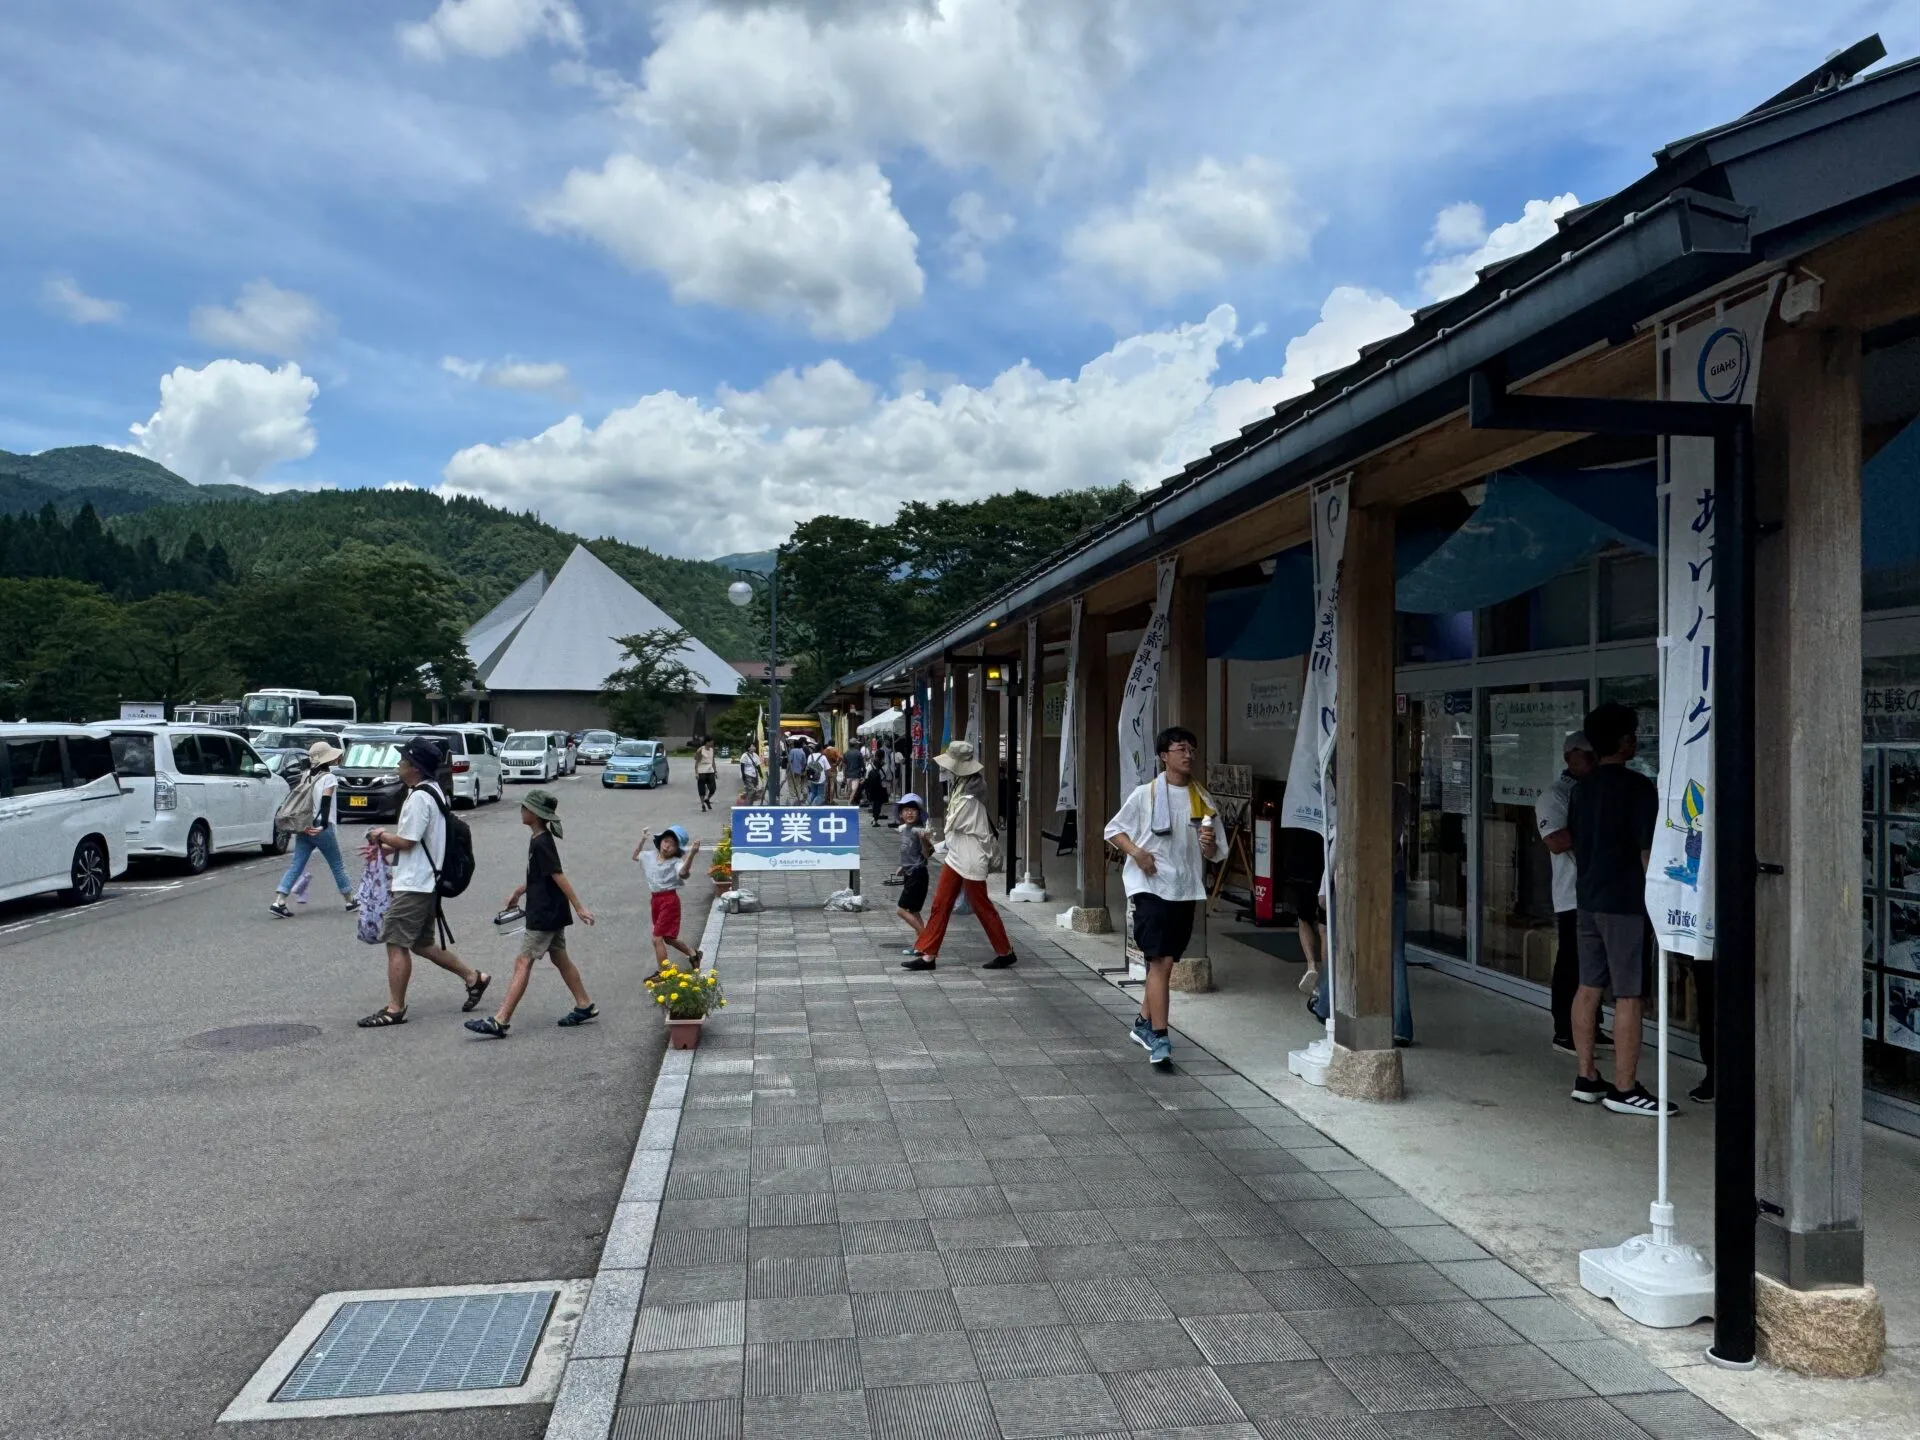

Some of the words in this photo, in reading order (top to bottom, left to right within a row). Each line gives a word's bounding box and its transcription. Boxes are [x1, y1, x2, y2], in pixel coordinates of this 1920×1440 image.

[1710, 359, 1737, 377] GIAHS
[744, 812, 847, 843] 営業中
